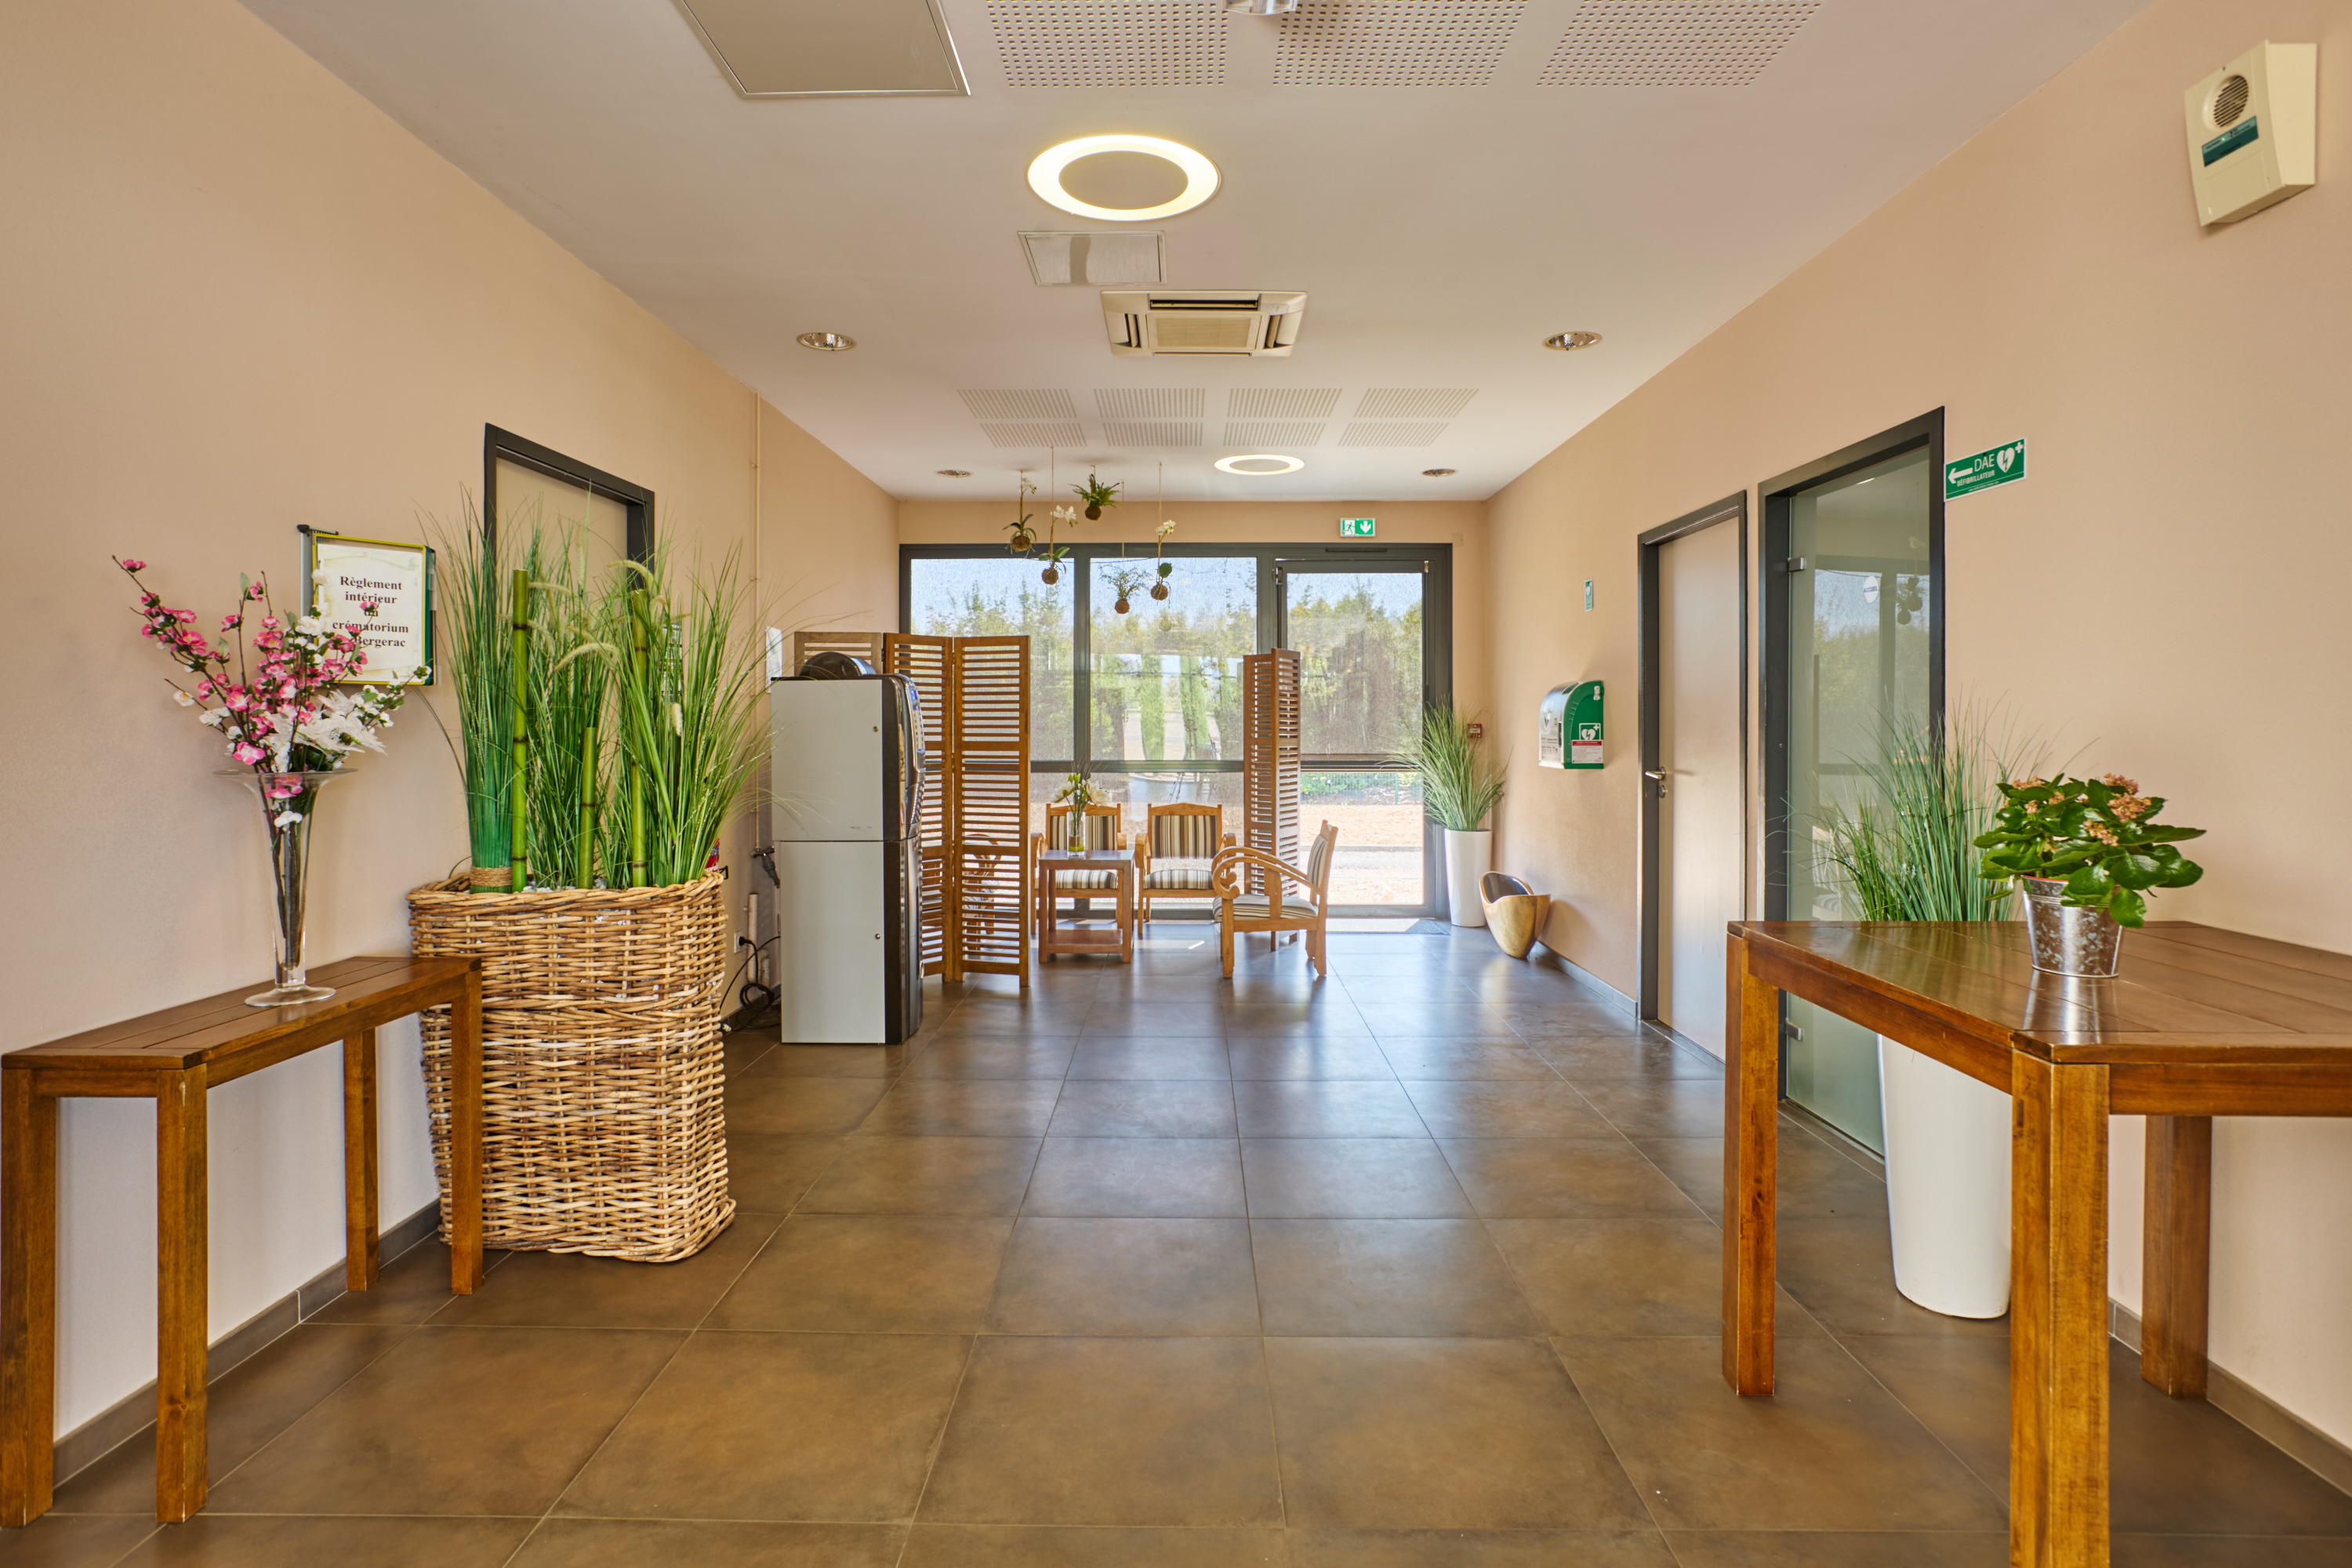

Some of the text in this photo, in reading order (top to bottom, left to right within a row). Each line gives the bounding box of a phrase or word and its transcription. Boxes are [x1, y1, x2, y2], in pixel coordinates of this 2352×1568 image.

[1974, 454, 1994, 472] DAE
[1957, 470, 1995, 487] DÉFIBRILLATEUR
[339, 575, 402, 590] Règlement
[345, 591, 397, 604] intérieur
